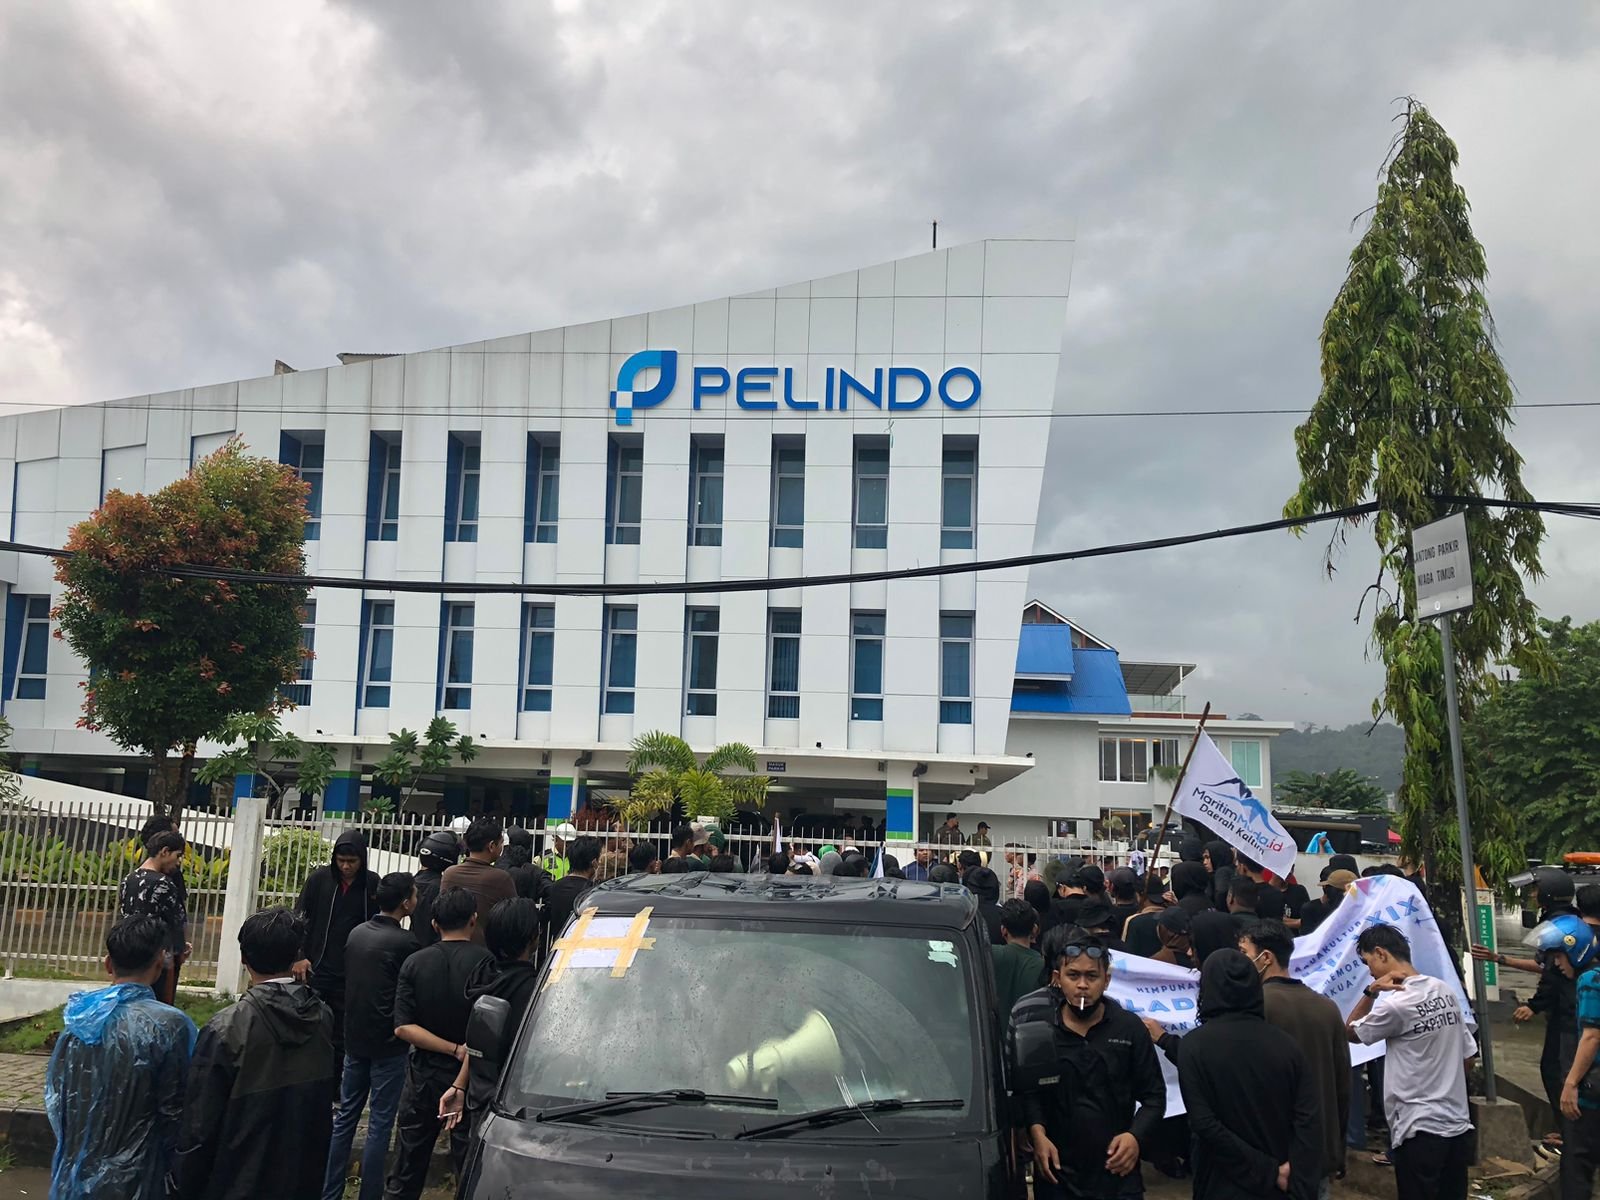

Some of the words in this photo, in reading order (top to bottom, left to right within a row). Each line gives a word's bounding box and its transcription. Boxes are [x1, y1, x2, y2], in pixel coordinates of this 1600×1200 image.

[693, 367, 982, 411] PELINDO
[1436, 566, 1455, 581] TIMUR
[1199, 803, 1235, 831] Daerah
